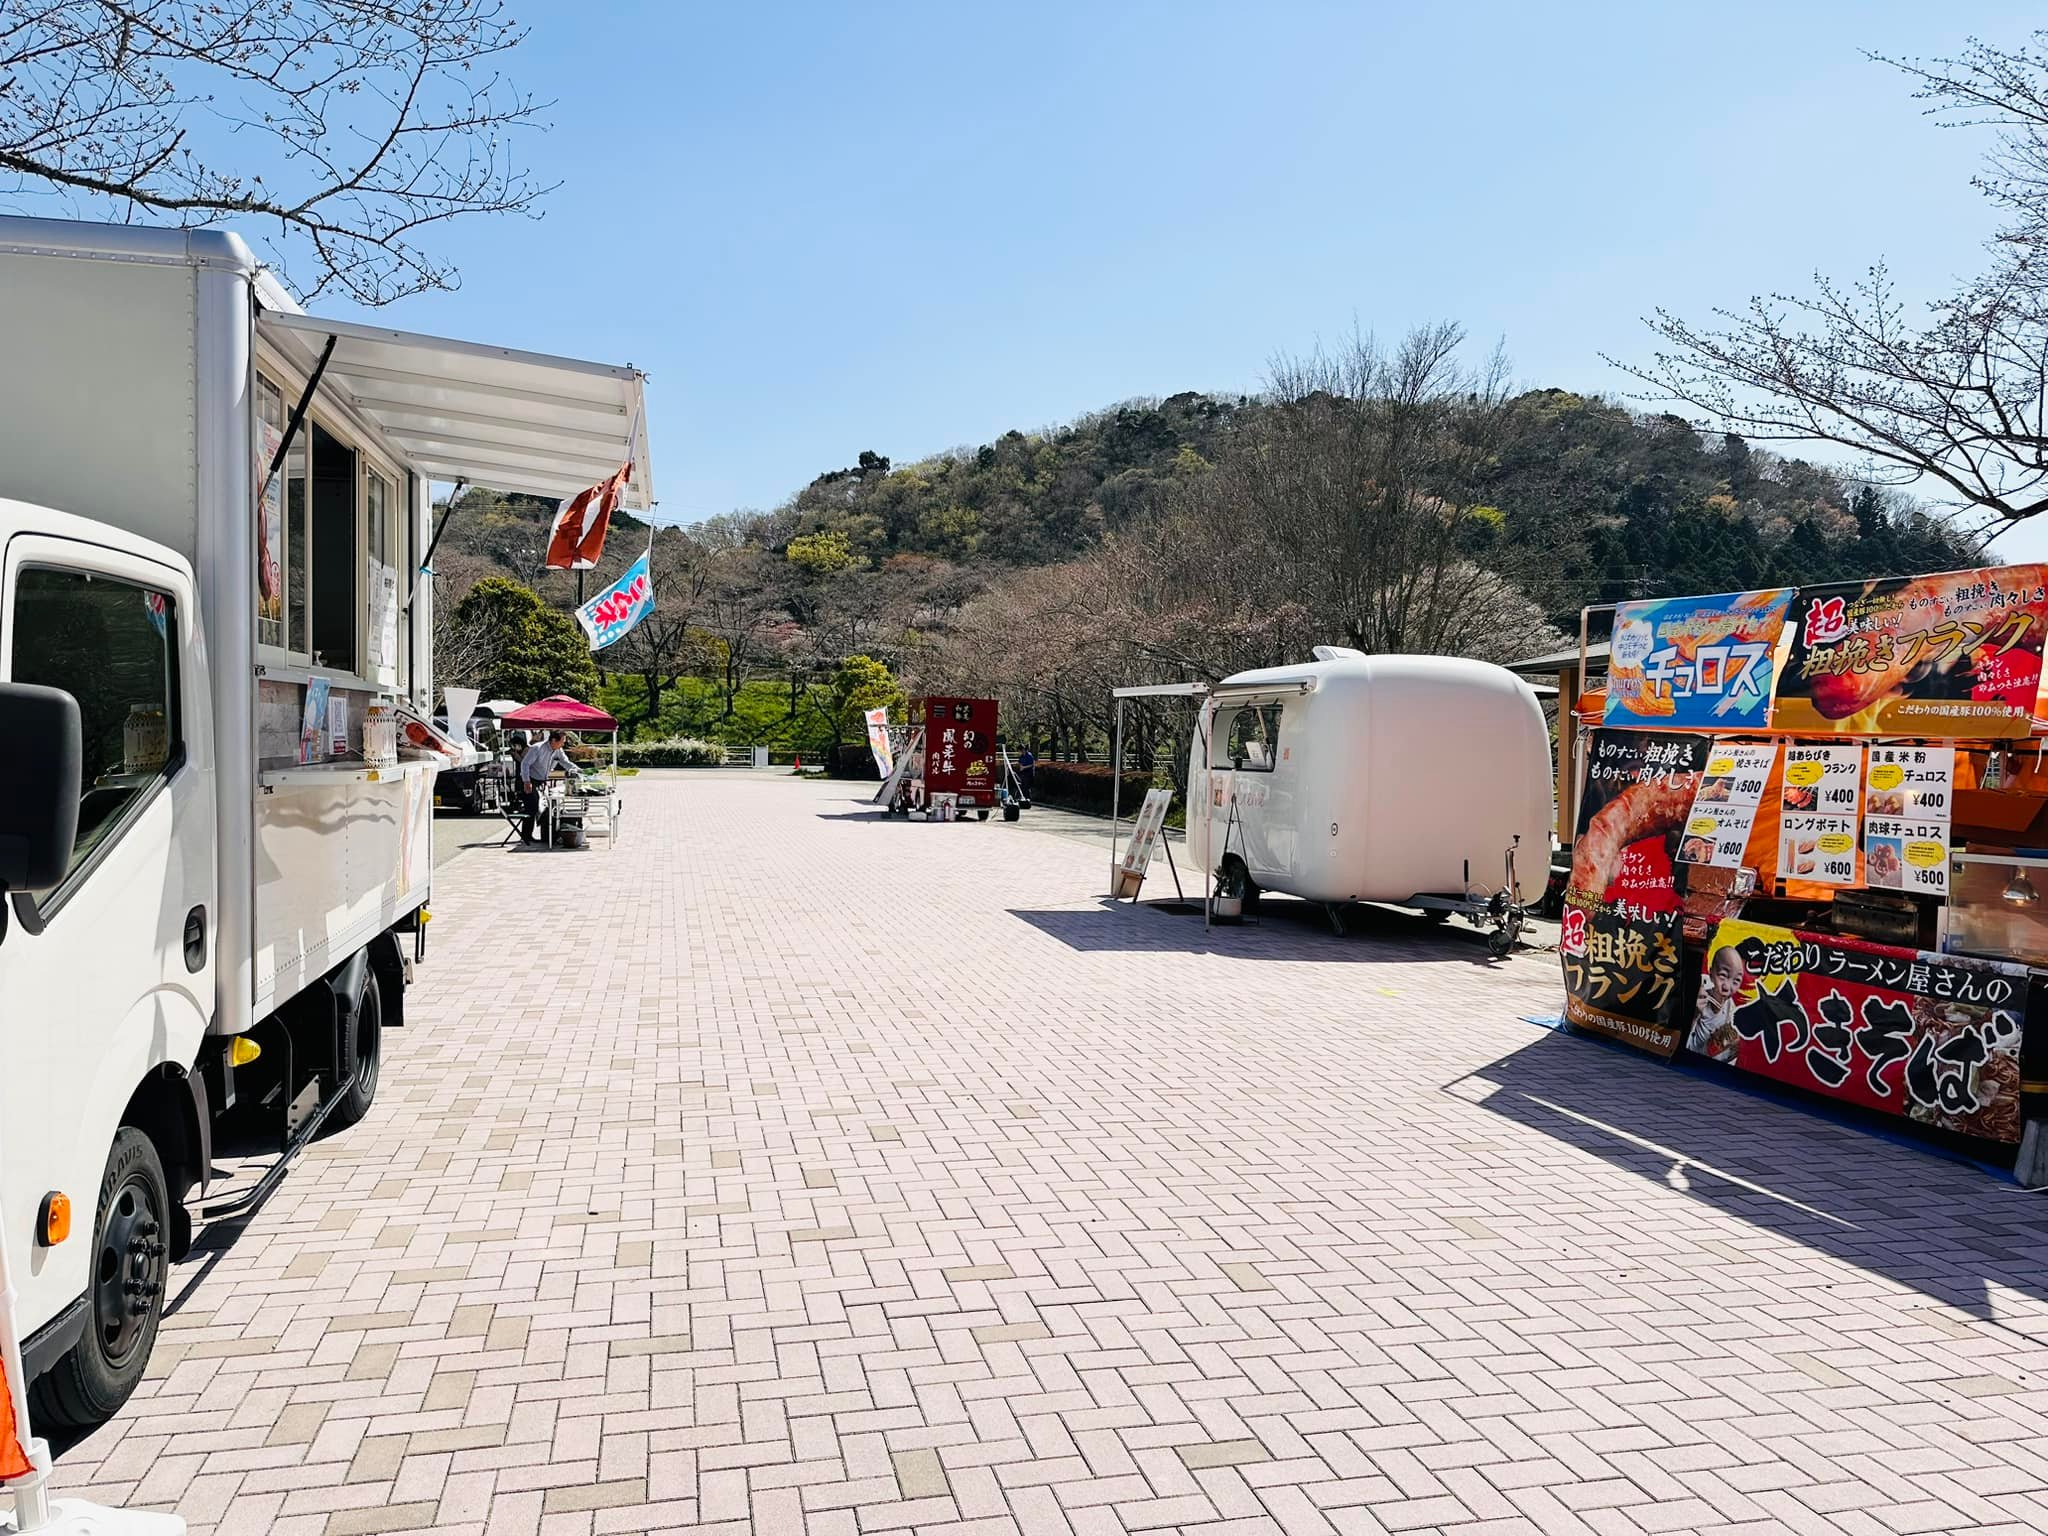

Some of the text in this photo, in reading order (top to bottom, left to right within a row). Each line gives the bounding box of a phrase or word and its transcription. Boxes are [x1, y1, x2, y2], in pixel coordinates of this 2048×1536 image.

[1803, 596, 1850, 649] 超
[1799, 610, 2035, 680] 粗挽きフランク
[1646, 642, 1772, 698] チュロス
[1897, 704, 2026, 718] こだわりの国産豚100%使用
[963, 729, 975, 749] 幻の
[1871, 751, 1927, 764] 国産米粉
[1823, 763, 1857, 774] フランク
[1904, 769, 1947, 783] チュロス
[1735, 780, 1762, 794] ¥500
[1824, 788, 1854, 804] ¥400
[1912, 792, 1945, 808] ¥400
[1717, 819, 1751, 829] オムそば
[1784, 818, 1851, 833] ロングポテト
[1868, 821, 1943, 840] 肉球チュロス
[1718, 841, 1743, 856] ¥600
[1823, 861, 1852, 876] ¥600
[1913, 870, 1945, 886] ¥500
[1613, 897, 1678, 929] 美味しい!
[1585, 923, 1680, 973] 粗挽き
[1745, 942, 2013, 1004] こだわり ラーメン屋さんの
[1565, 963, 1676, 1011] フランク
[1731, 975, 2021, 1114] やきそば
